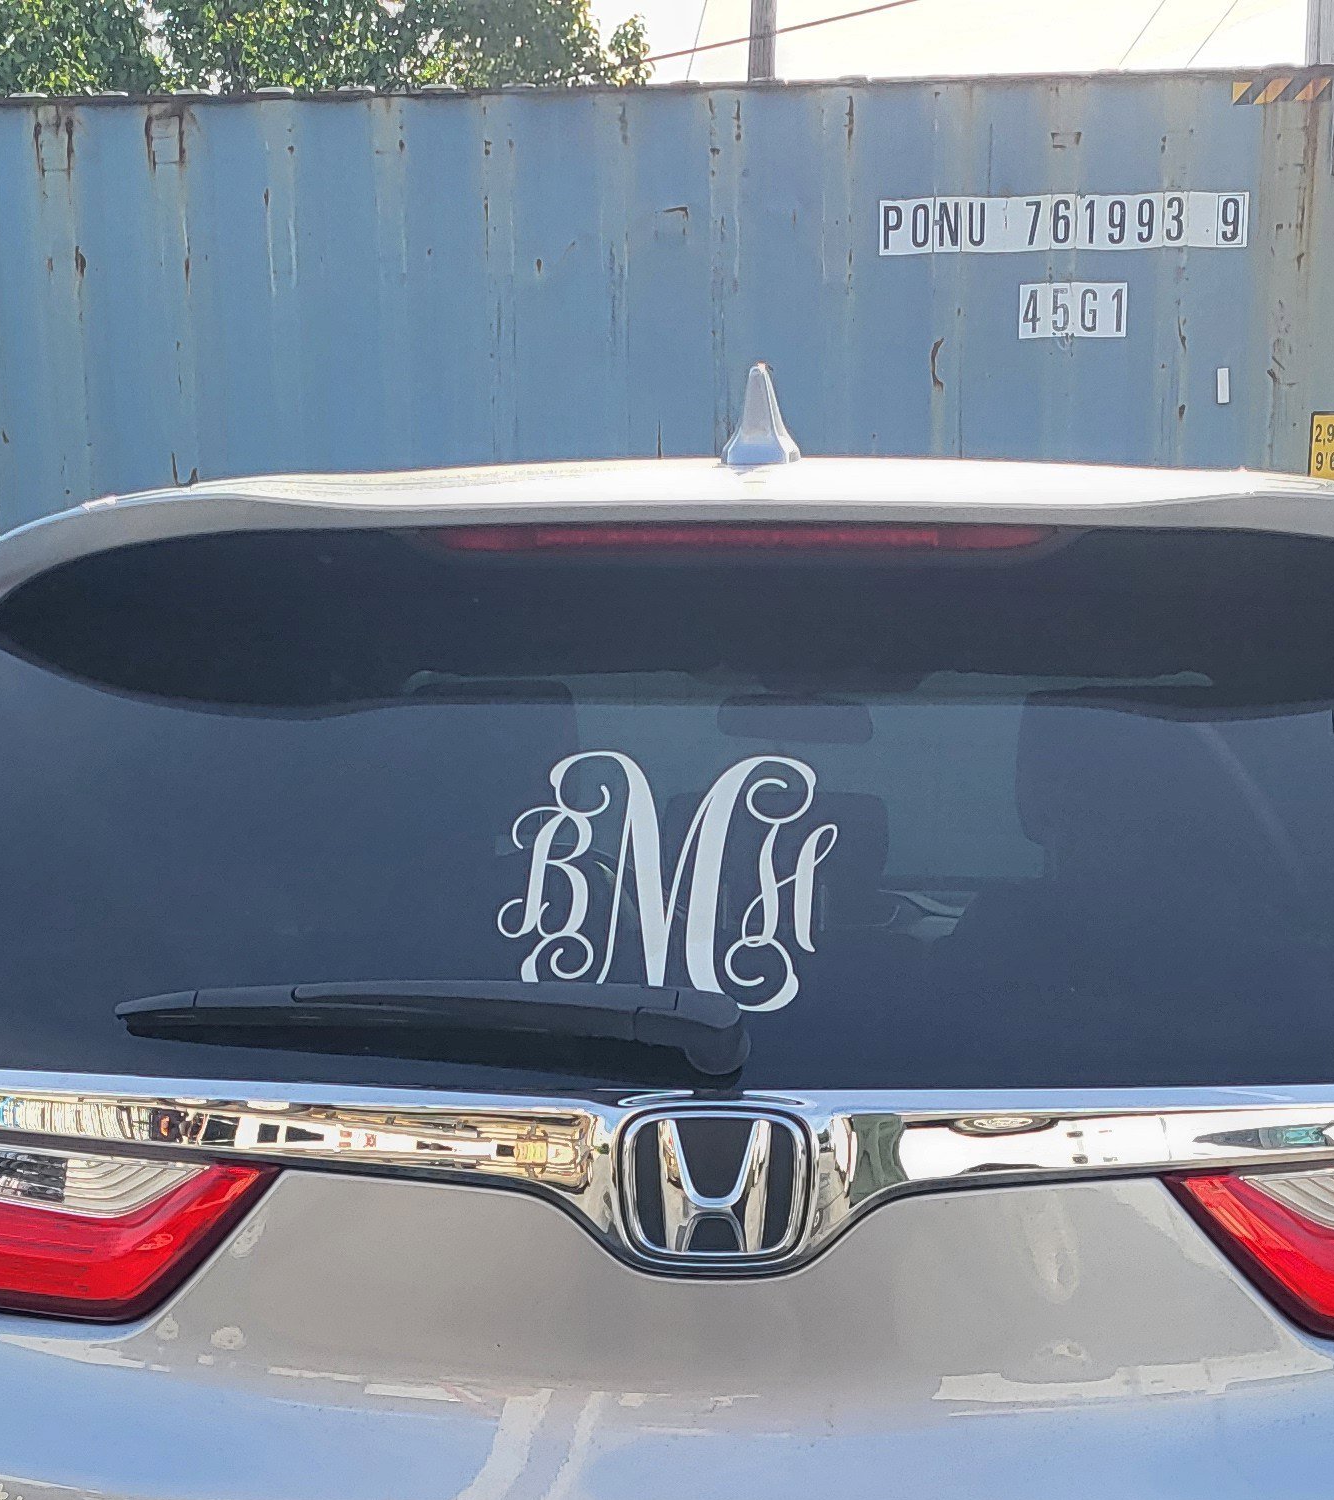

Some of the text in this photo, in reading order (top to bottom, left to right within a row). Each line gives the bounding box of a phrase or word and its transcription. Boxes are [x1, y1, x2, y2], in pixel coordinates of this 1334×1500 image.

[882, 195, 1241, 250] PONU 761993 9
[1021, 287, 1125, 334] 45G1
